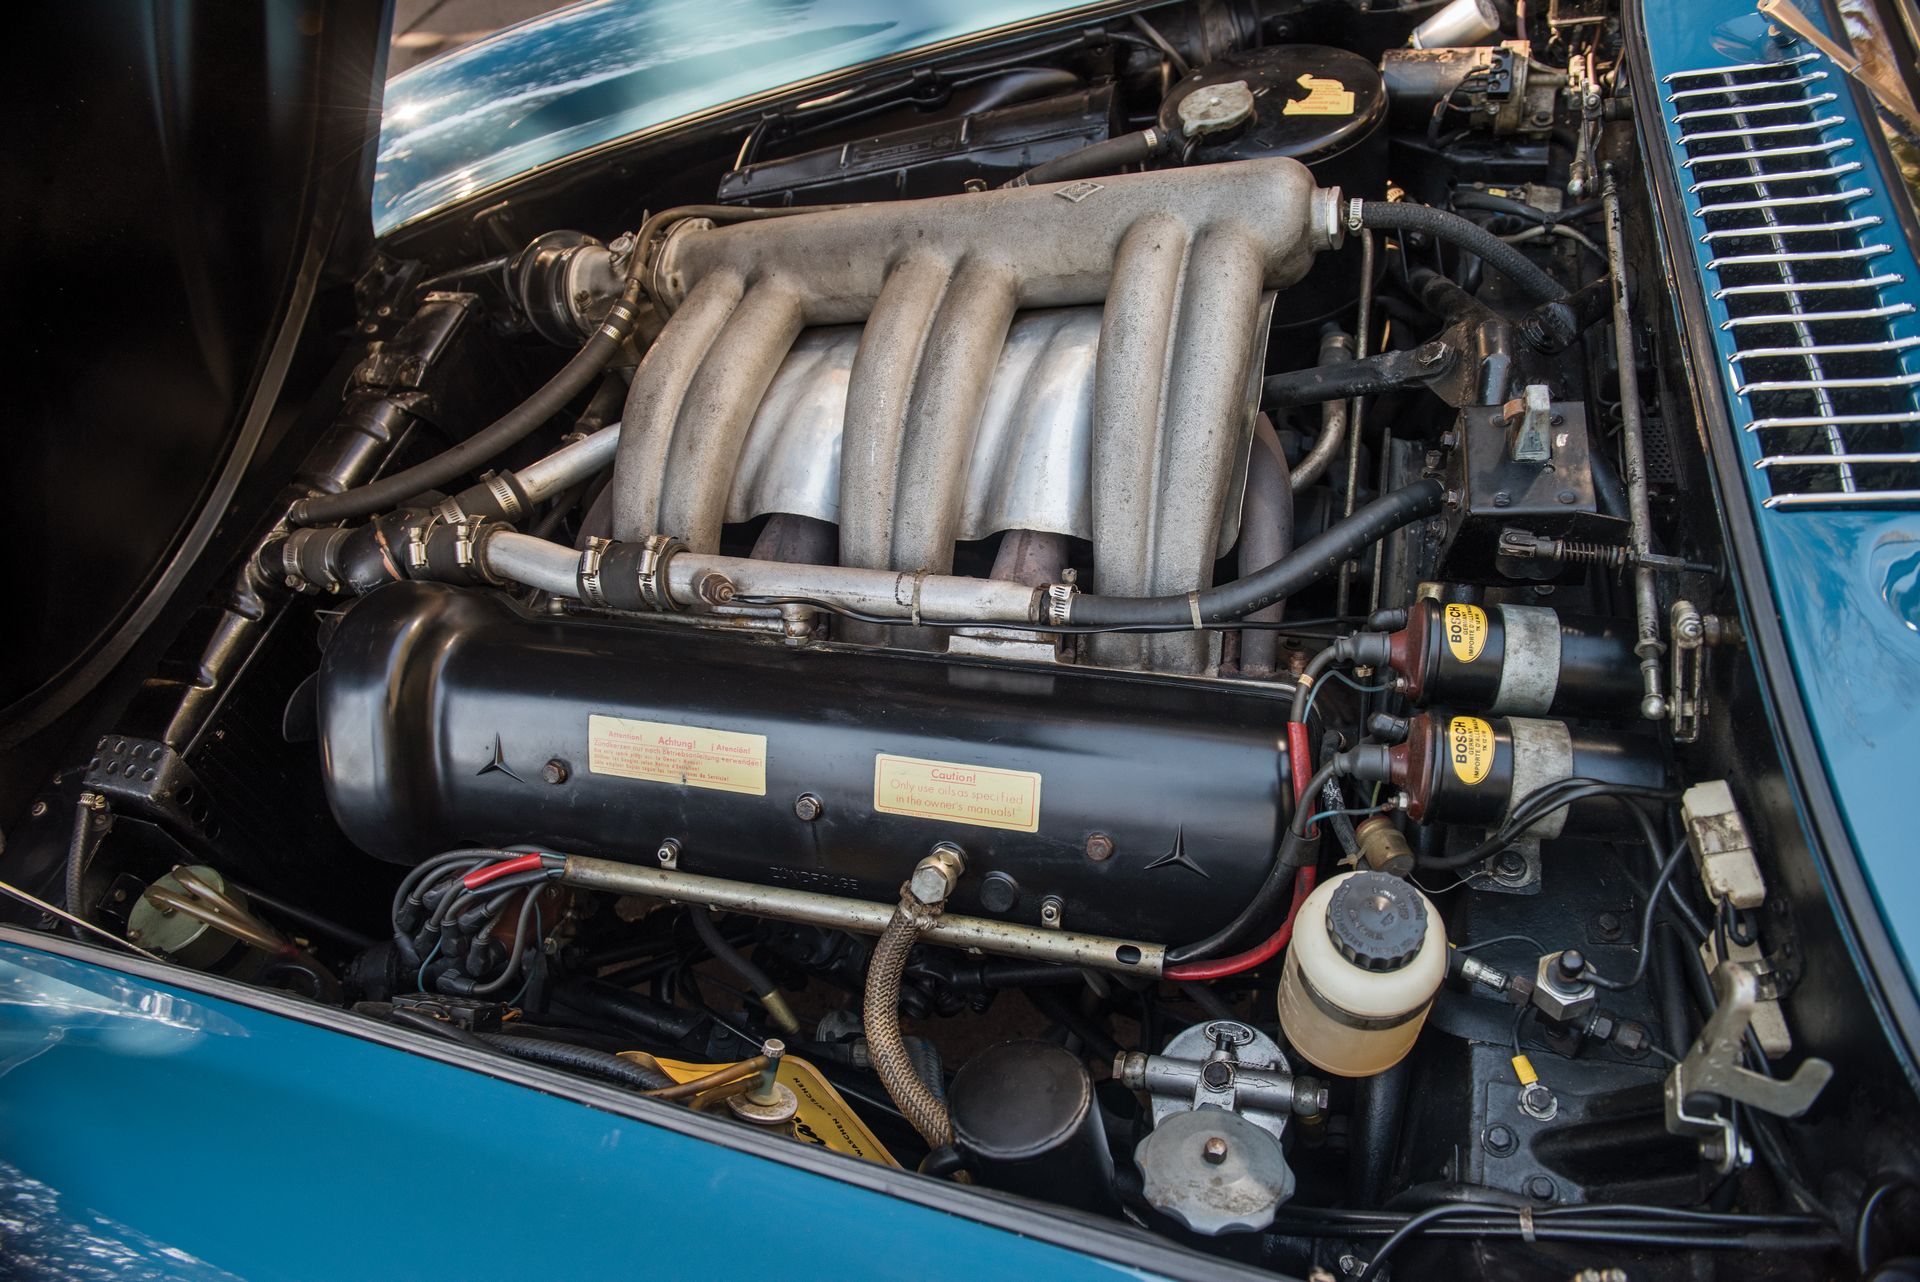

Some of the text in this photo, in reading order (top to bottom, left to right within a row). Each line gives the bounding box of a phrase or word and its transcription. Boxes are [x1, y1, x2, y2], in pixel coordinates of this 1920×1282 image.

[1448, 606, 1462, 643] BOSCH
[608, 731, 642, 741] Attention!
[658, 736, 696, 750] Achtung!
[1454, 721, 1467, 764] BOSCH
[931, 768, 976, 784] Caution!
[890, 778, 1023, 806] Only use oils as specified
[896, 794, 1016, 818] in the owner's manuals!
[793, 1078, 825, 1111] WISCHEN
[832, 1118, 864, 1158] WASCHEN
